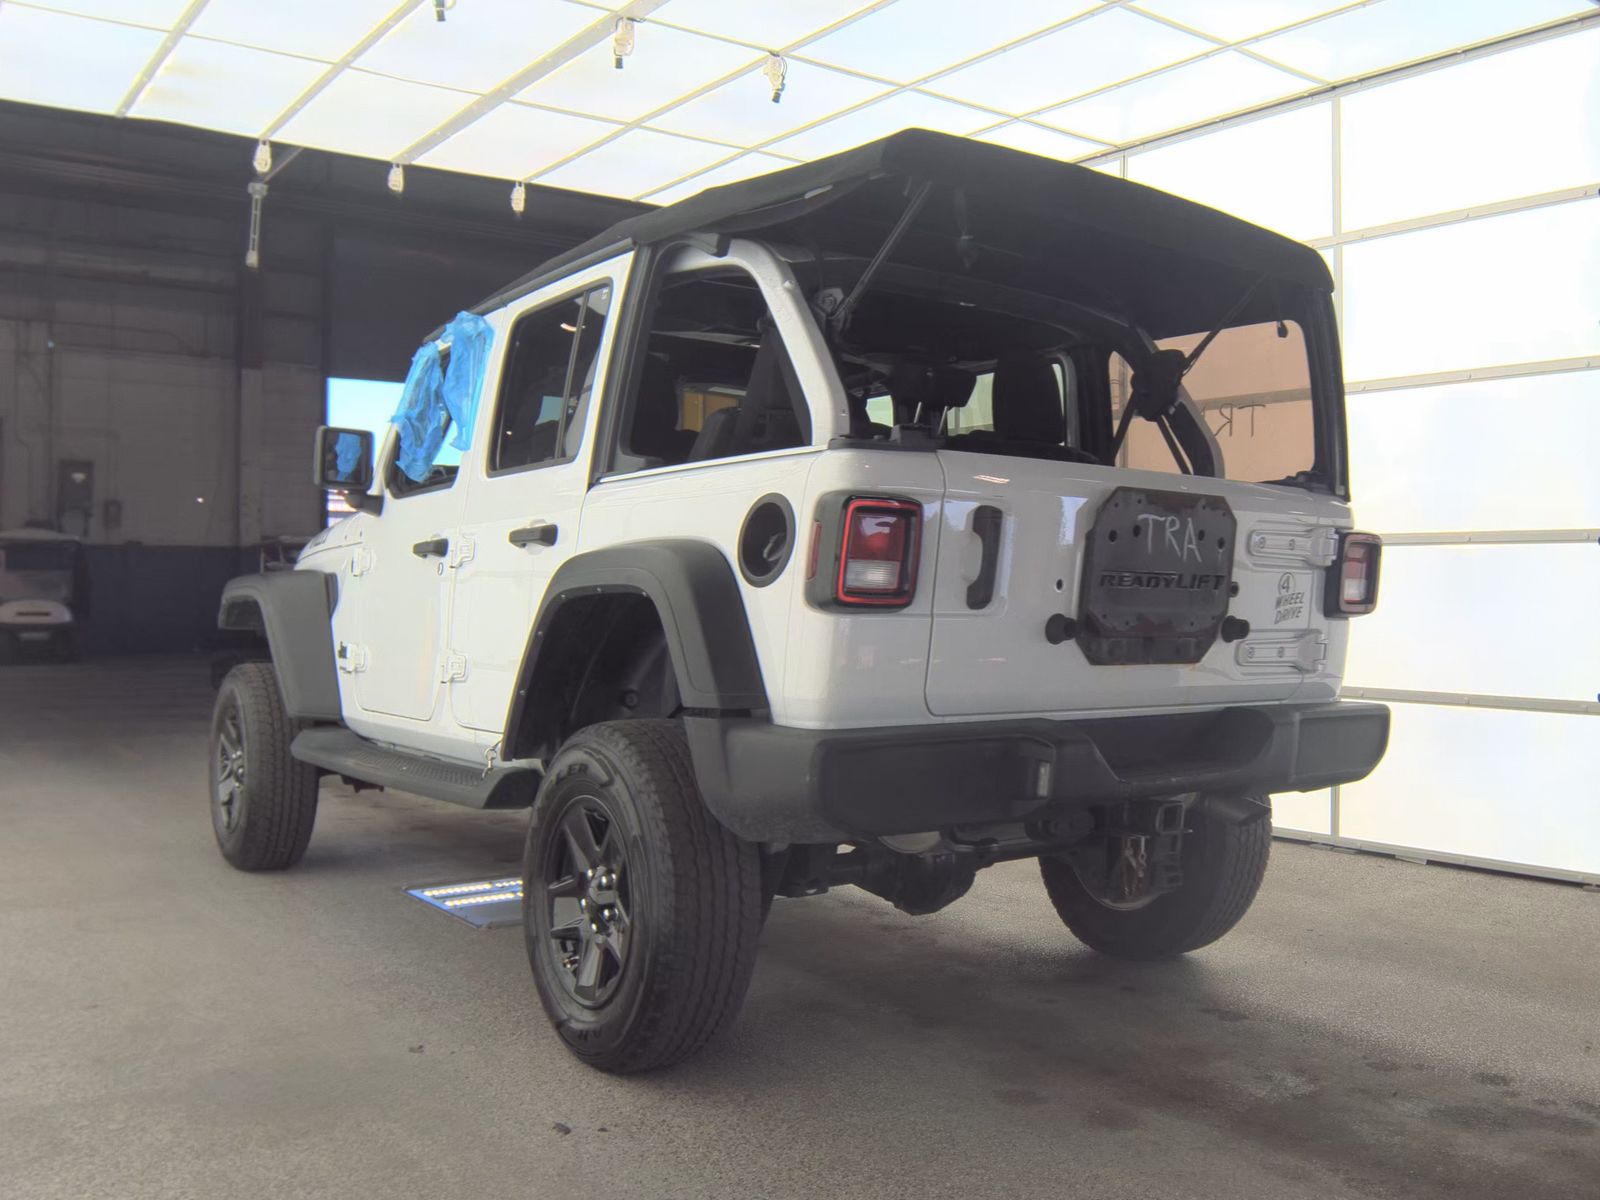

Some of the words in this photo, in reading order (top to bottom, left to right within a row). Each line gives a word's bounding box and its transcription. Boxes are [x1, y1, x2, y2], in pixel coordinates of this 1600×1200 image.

[1137, 513, 1202, 563] TRA
[1099, 572, 1226, 591] READYLIFT
[1275, 592, 1305, 610] WHEEL
[1273, 606, 1304, 625] DRIVE
